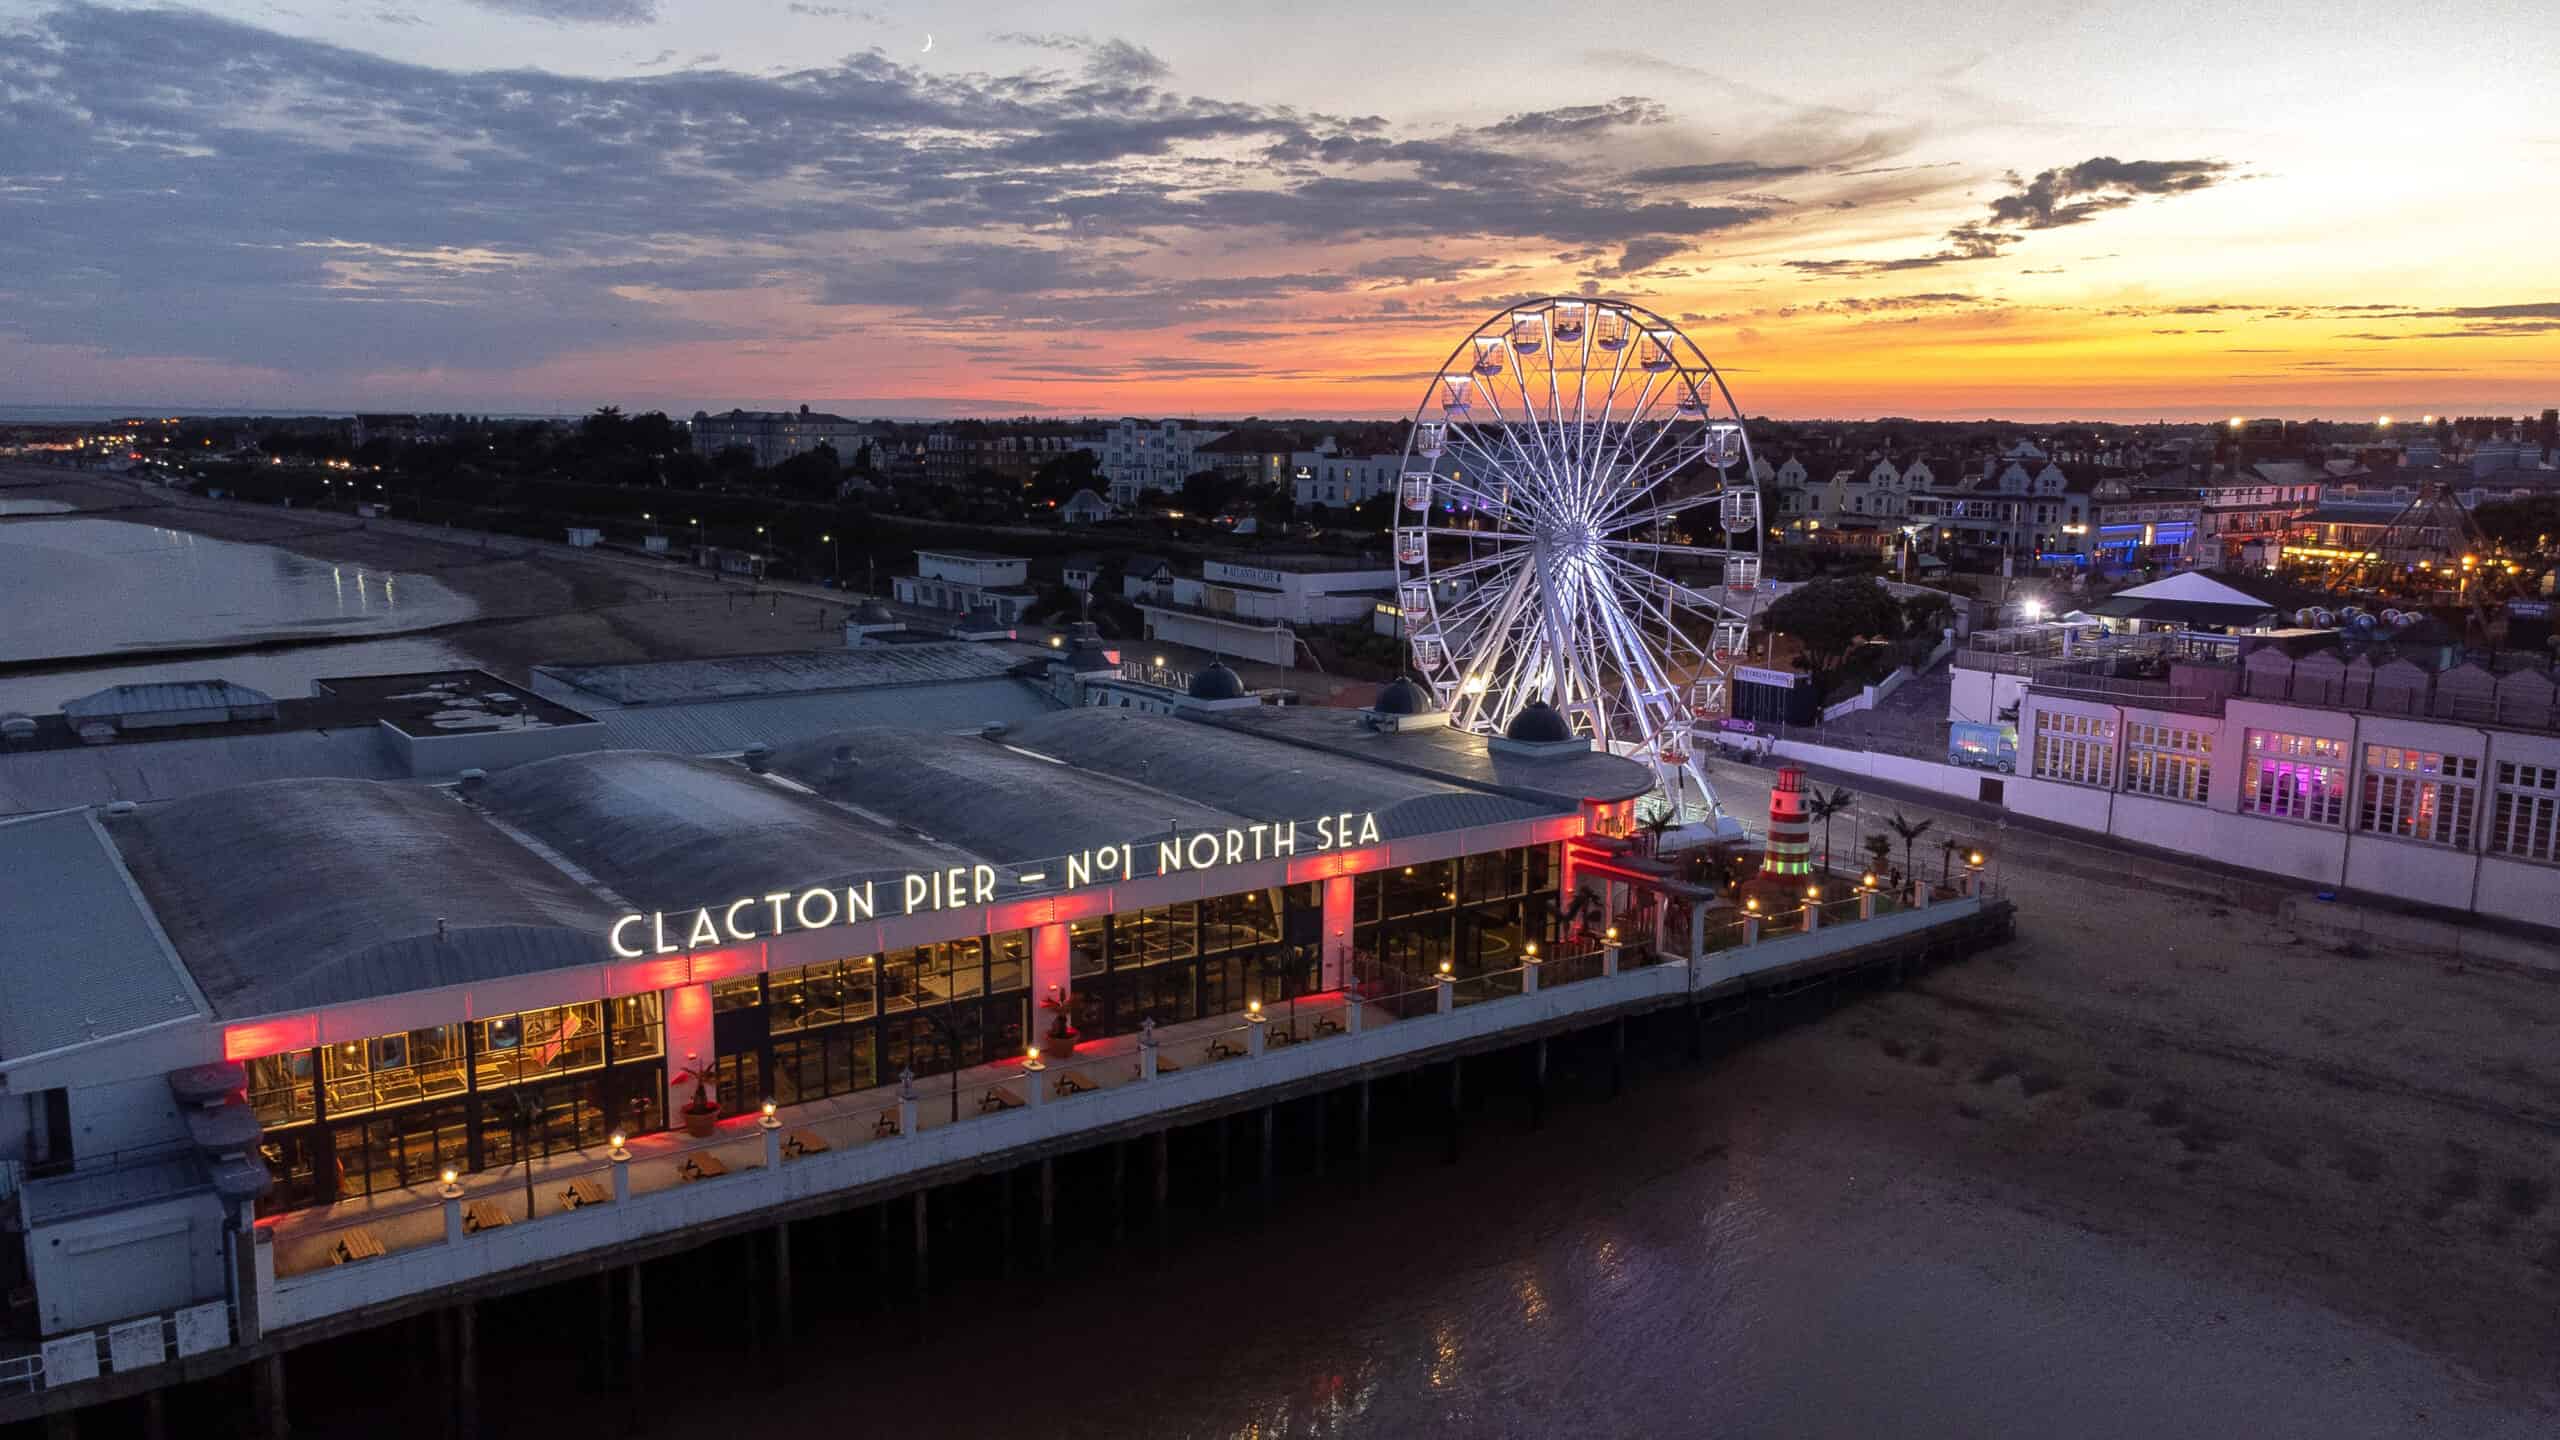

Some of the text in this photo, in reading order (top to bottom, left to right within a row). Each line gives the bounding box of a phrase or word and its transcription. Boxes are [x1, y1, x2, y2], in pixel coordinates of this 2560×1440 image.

[610, 880, 874, 957] CLACTON
[905, 864, 996, 914] PIER
[1160, 821, 1295, 875] NORTH
[1317, 812, 1380, 850] SEA
